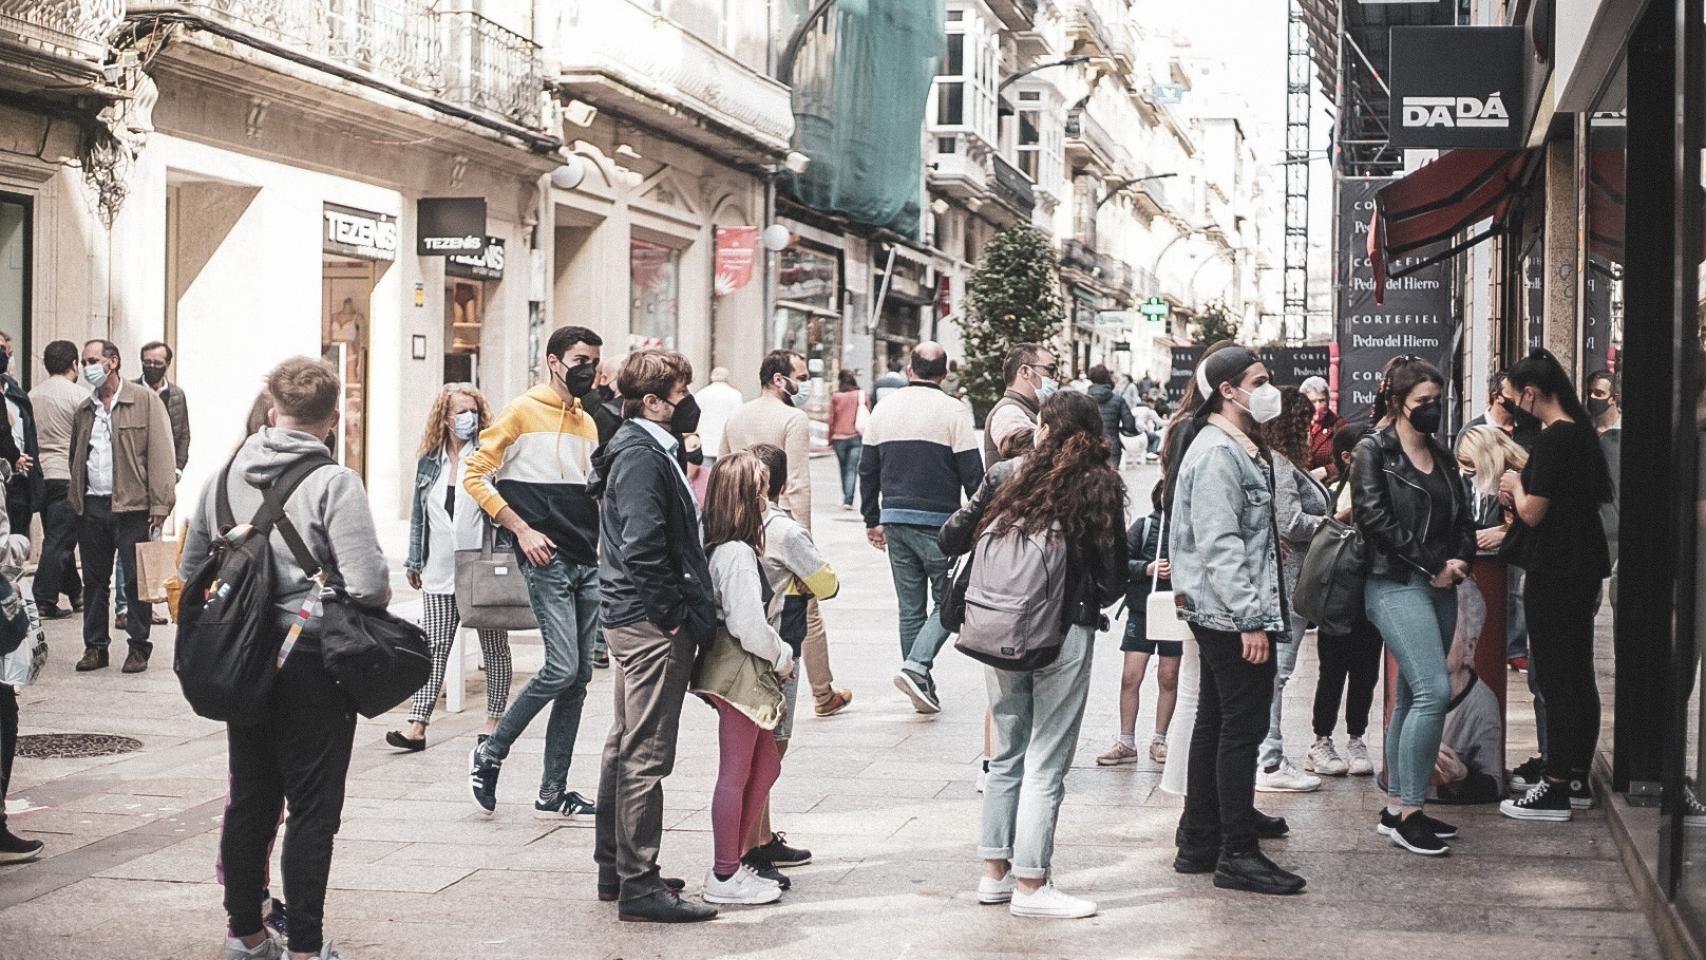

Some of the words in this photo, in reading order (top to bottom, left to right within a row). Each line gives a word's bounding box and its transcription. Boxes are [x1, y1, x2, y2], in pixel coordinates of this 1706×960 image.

[1403, 91, 1509, 127] DADÁ
[1386, 278, 1402, 290] del
[1404, 277, 1440, 290] Hierro
[1352, 315, 1438, 324] CORTEFIEL
[1353, 334, 1384, 348] Pedro
[1385, 334, 1401, 348] del
[1403, 334, 1439, 348] Hierro
[1353, 390, 1377, 404] Pedr
